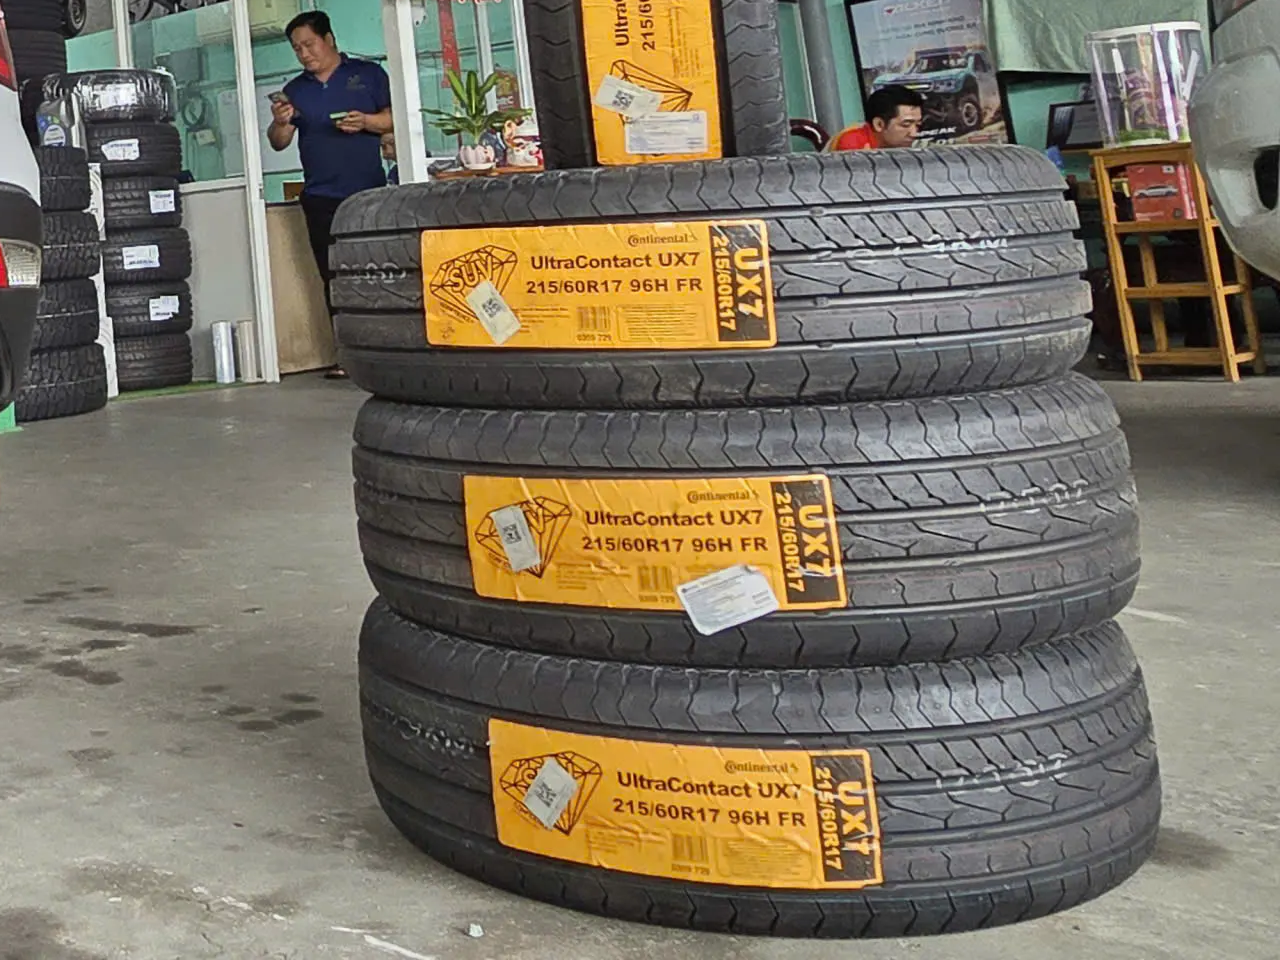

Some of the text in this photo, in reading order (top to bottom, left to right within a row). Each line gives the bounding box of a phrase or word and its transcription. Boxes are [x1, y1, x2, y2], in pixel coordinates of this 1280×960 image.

[627, 233, 688, 247] Continental
[531, 252, 700, 270] UltraContact UX7
[526, 278, 703, 295] 215/60R17 96H FR
[713, 235, 737, 331] 215/60R17
[734, 248, 764, 319] UX7
[586, 509, 763, 526] UltraContact UX7
[582, 536, 769, 553] 215/60R17 96H FR
[776, 492, 805, 592] 215/60R17
[799, 504, 831, 576] UX7
[617, 771, 802, 800] UltraContact UX7
[613, 798, 807, 827] 215/60R17 96H FR
[814, 767, 843, 870] 215/60R17
